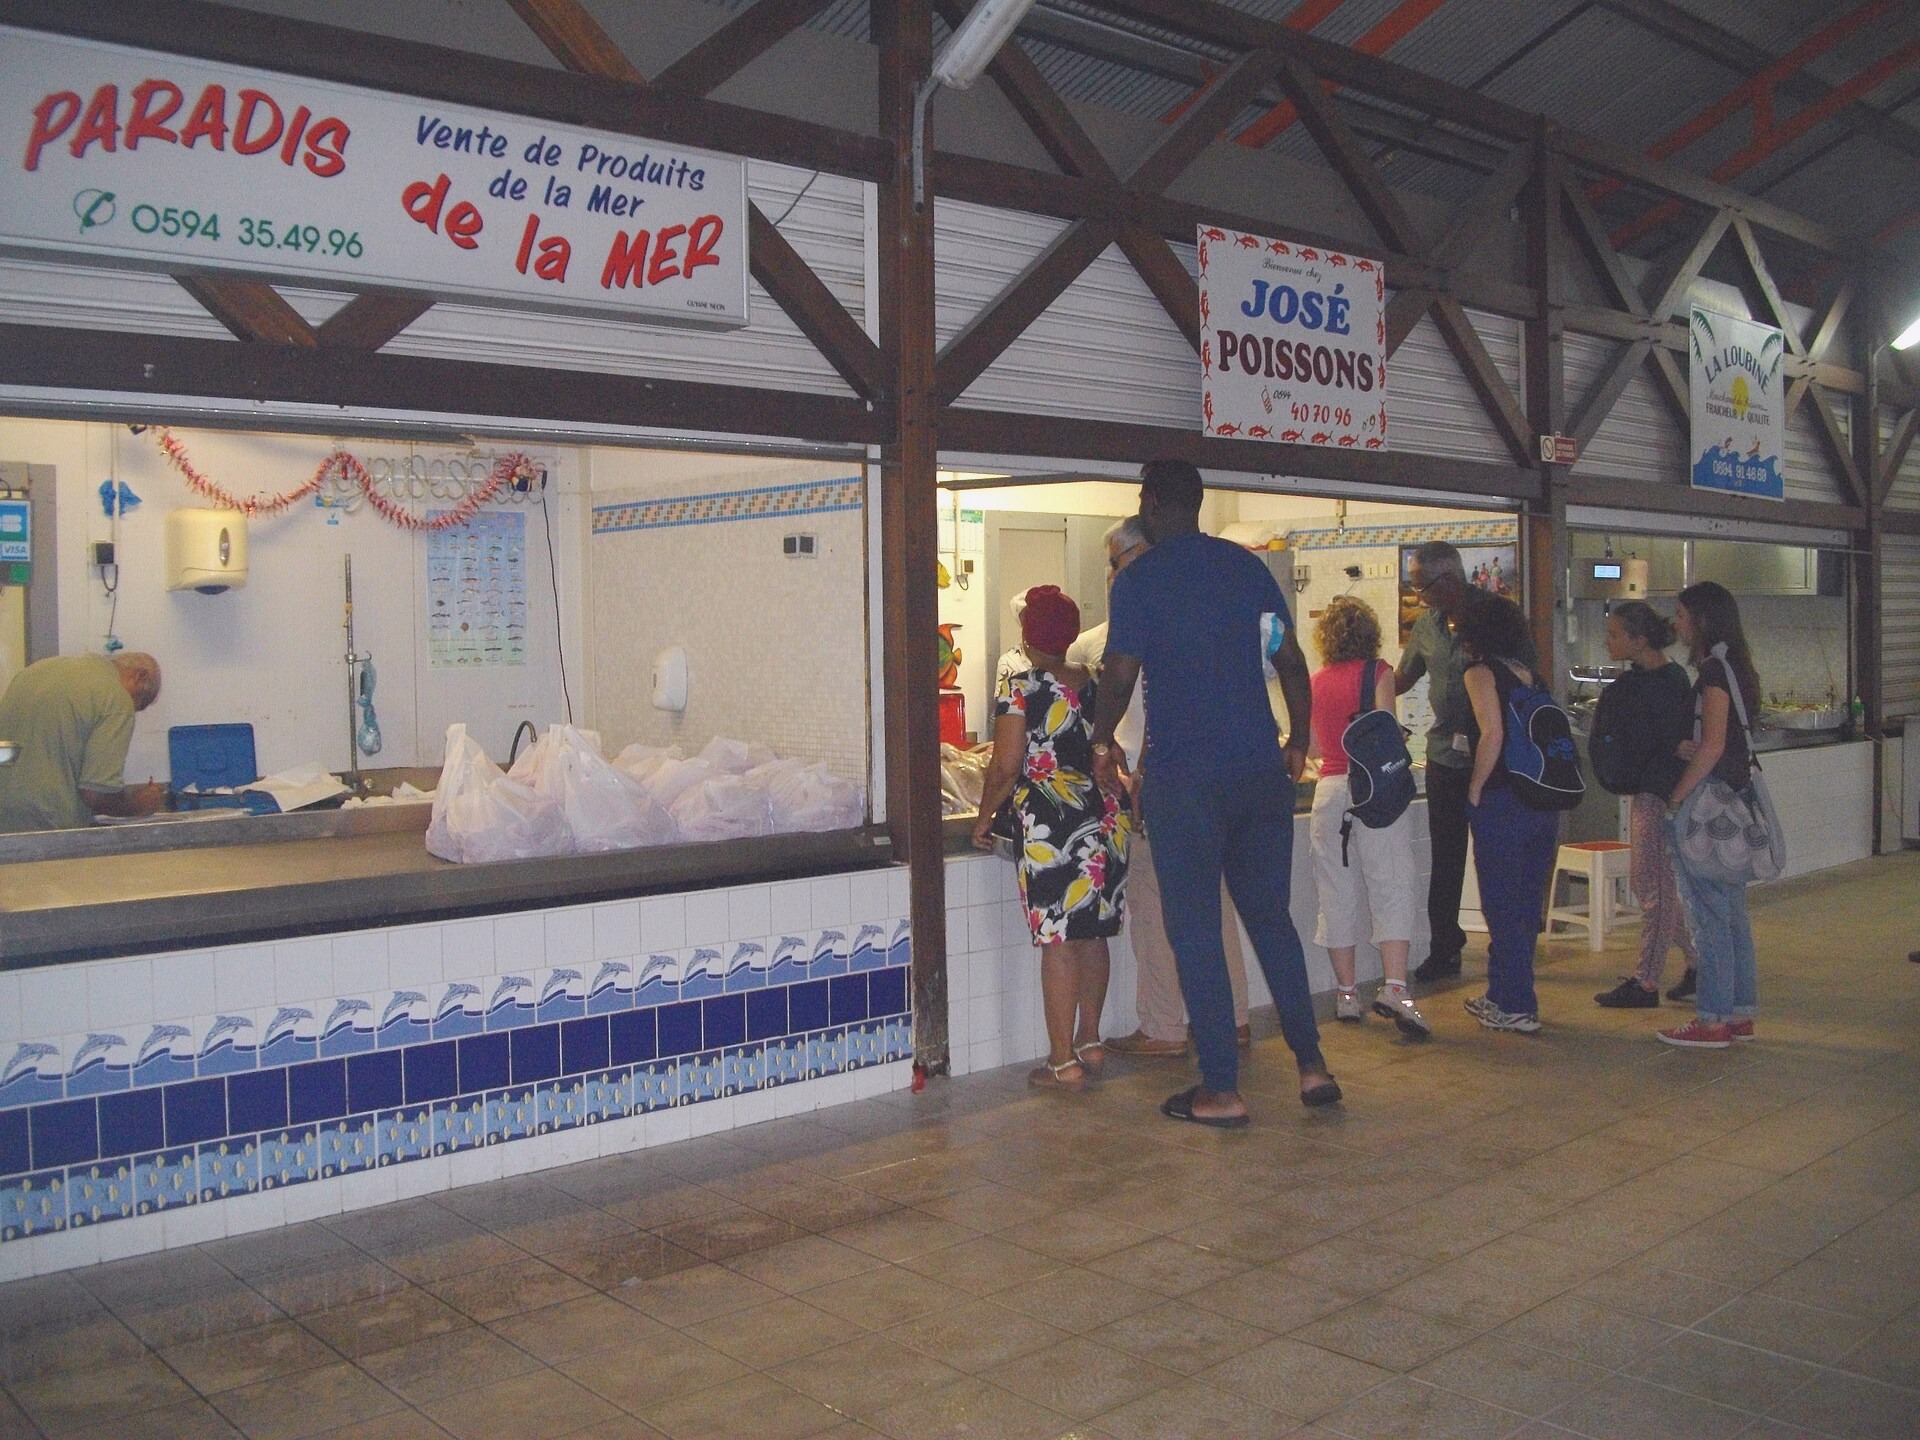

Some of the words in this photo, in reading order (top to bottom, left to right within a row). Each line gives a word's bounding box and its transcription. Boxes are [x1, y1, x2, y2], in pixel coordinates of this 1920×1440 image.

[24, 78, 351, 178] PARADIS
[416, 115, 508, 159] Vente
[523, 135, 562, 167] de
[578, 143, 705, 191] Produits
[488, 169, 528, 201] de
[544, 175, 572, 208] la
[587, 183, 645, 218] Mer
[131, 203, 220, 242] 0594
[238, 217, 363, 258] 35.49.96
[401, 172, 484, 250] de
[515, 213, 571, 283] la
[601, 214, 724, 290] MER
[1262, 257, 1303, 277] Bienvenue
[1240, 279, 1350, 336] JOSÉ
[1216, 329, 1374, 393] POISSONS
[1705, 355, 1722, 384] LA
[1723, 345, 1769, 395] LOUBINE
[1291, 402, 1309, 423] 40
[1335, 408, 1352, 427] 96
[5, 546, 27, 554] VISA
